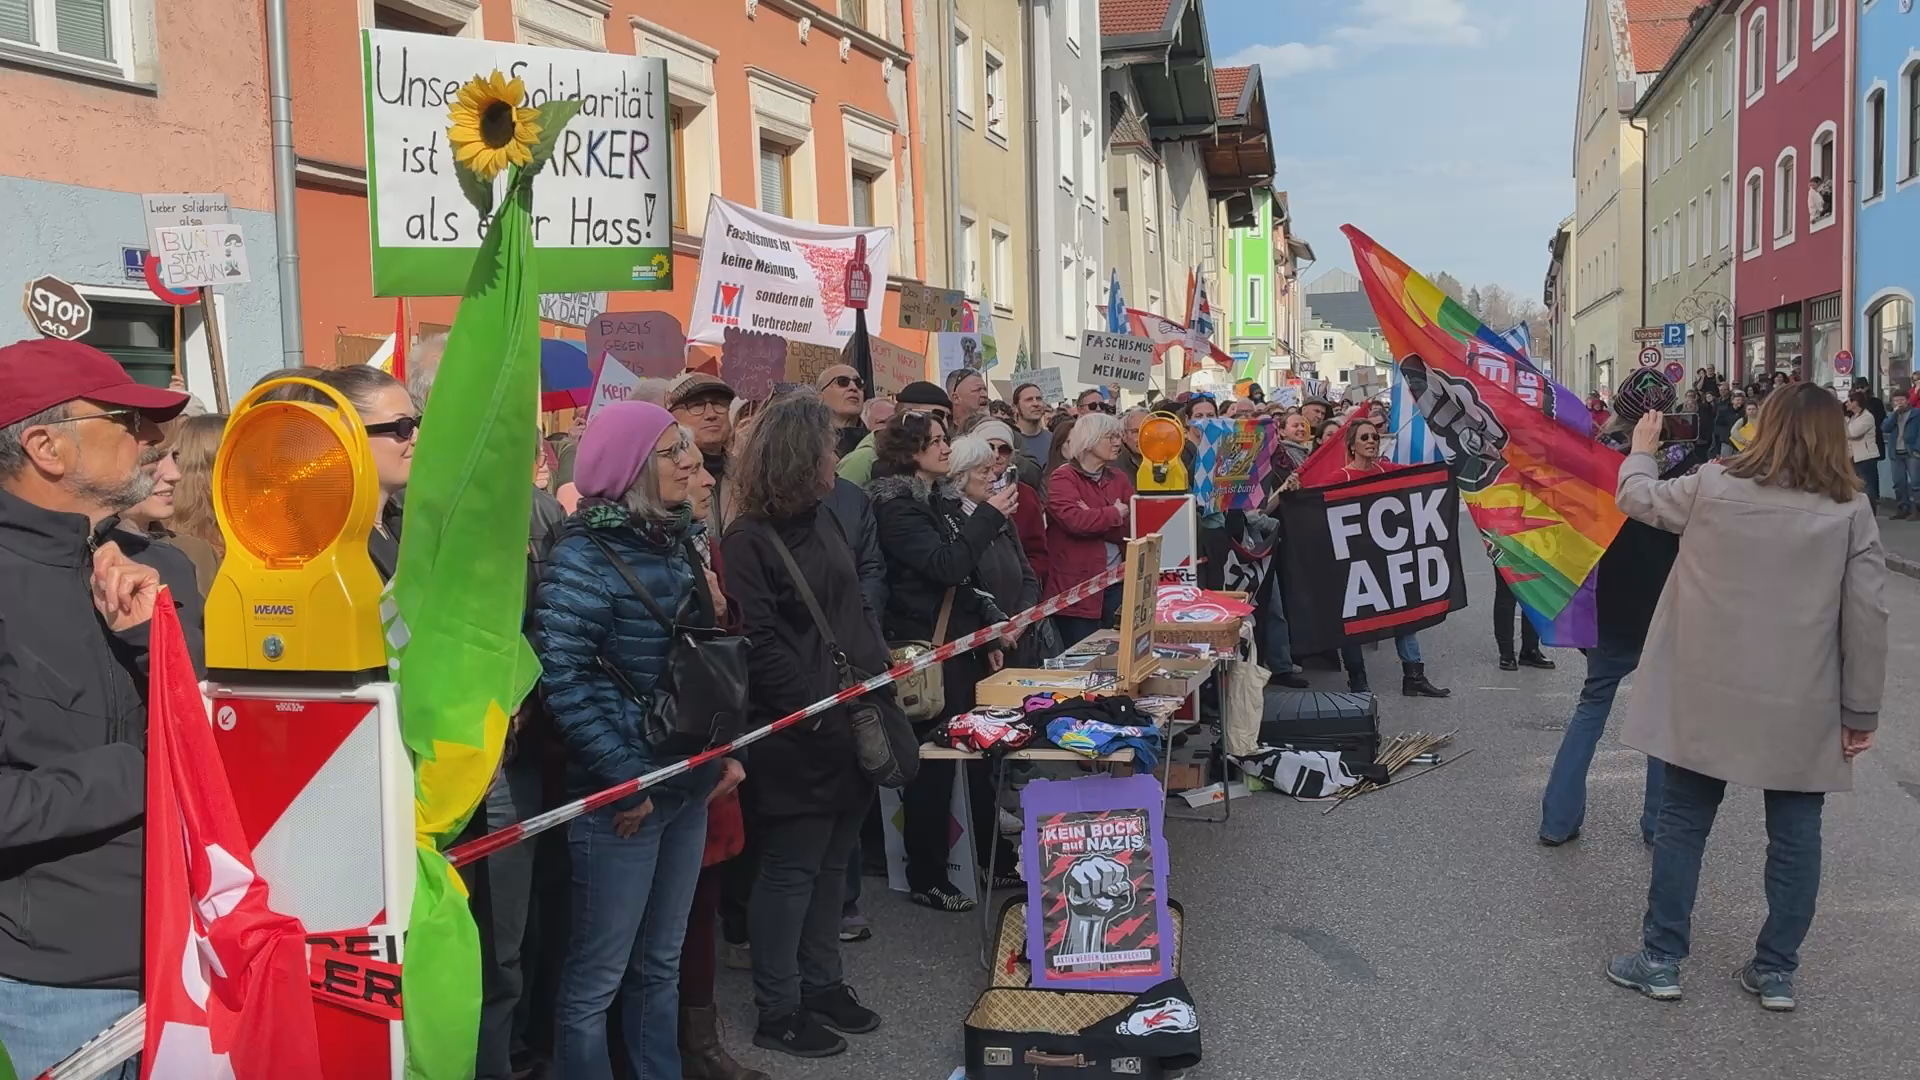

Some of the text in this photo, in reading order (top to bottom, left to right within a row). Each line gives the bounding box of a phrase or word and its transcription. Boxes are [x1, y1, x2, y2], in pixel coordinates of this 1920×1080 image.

[402, 130, 651, 179] ist RKER
[406, 196, 459, 241] als
[571, 193, 656, 245] Hass!
[162, 229, 225, 251] BUNT
[726, 224, 792, 253] Faschismus ist
[168, 263, 226, 284] BRAUN
[721, 252, 798, 280] keine Meinung,
[32, 287, 85, 326] STOP
[755, 289, 814, 309] sondern ein
[41, 320, 68, 337] AfD
[600, 320, 653, 337] BAZIS
[752, 313, 812, 333] Verbrechen!
[1086, 334, 1154, 353] FASCHISMUS
[1636, 331, 1664, 339] Vorber
[1668, 326, 1681, 343] P
[603, 340, 644, 351] GEGEN
[621, 360, 644, 374] ZIS
[1103, 353, 1141, 366] ist keine
[1643, 352, 1657, 363] 50
[1092, 363, 1145, 382] MEINUNG
[1326, 488, 1449, 560] FCK
[1342, 546, 1450, 618] AFD
[254, 604, 294, 615] WEMAS
[1045, 821, 1138, 842] KEIN BOCK
[1062, 834, 1144, 852] auf NAZIS
[1056, 956, 1074, 964] AKTIV
[1076, 954, 1099, 962] WERDEN
[1102, 953, 1123, 961] GEGEN
